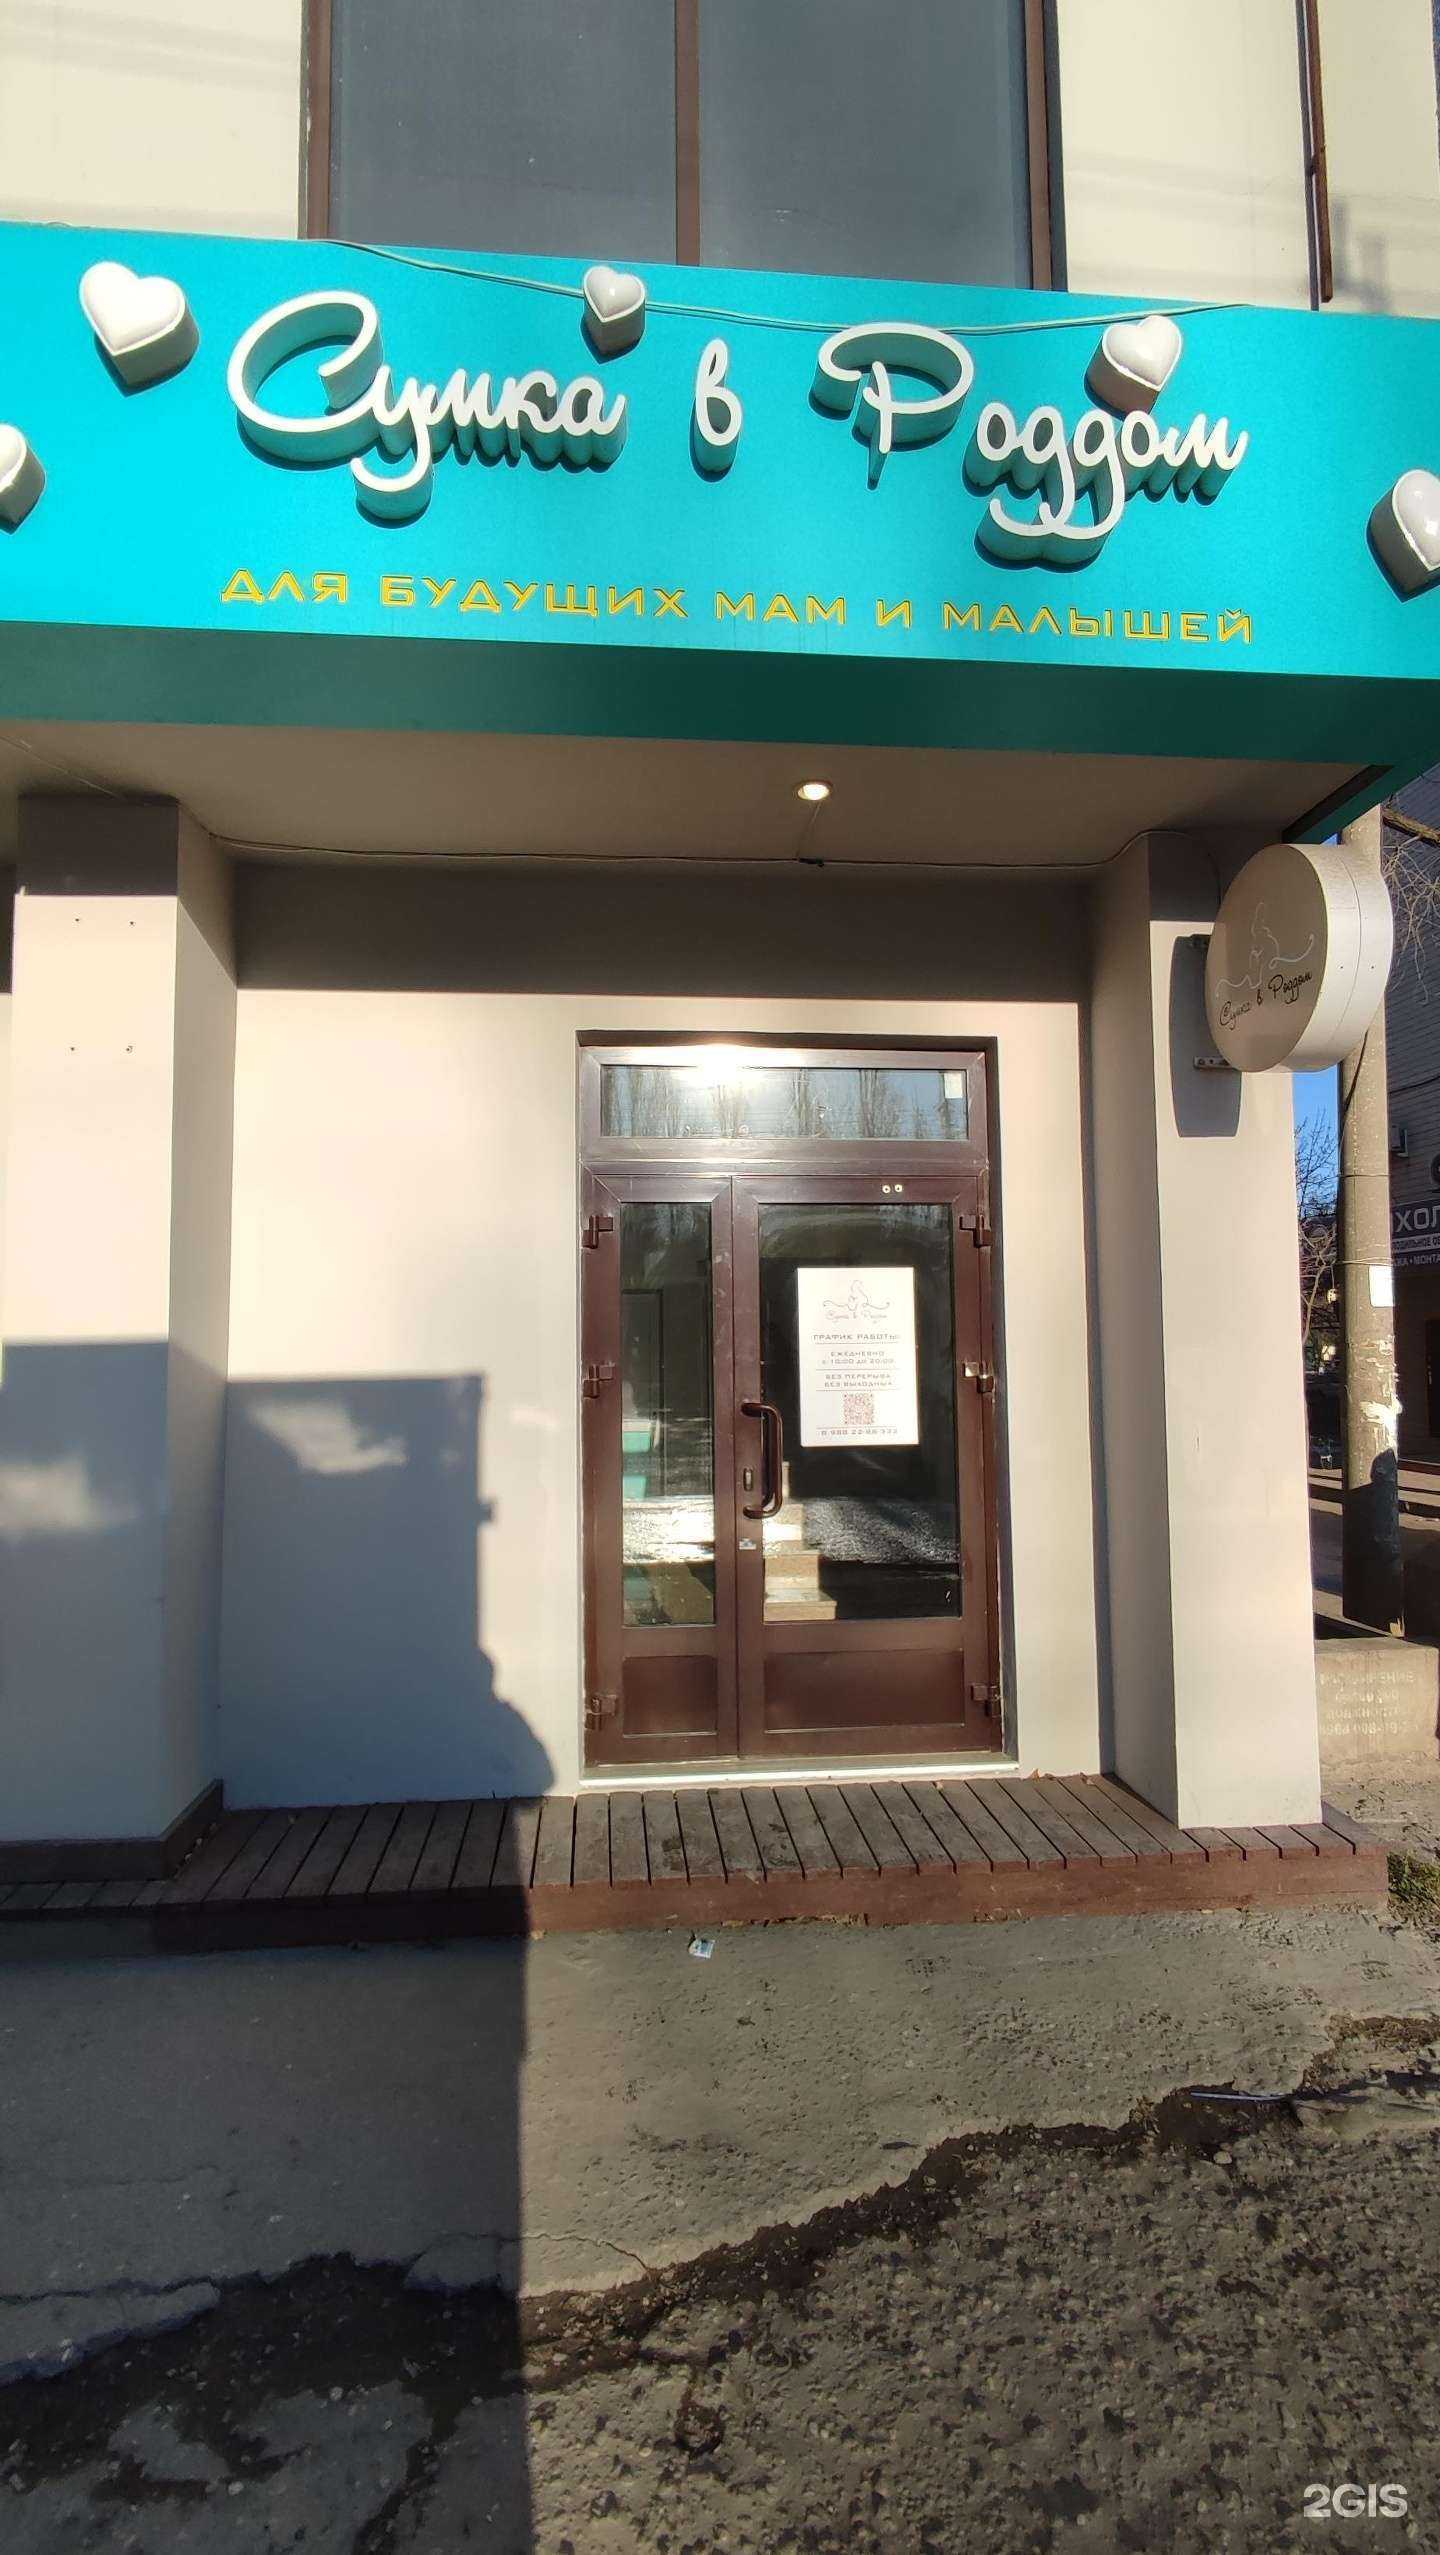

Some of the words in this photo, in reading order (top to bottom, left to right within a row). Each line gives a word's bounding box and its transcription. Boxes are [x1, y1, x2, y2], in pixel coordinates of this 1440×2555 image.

[227, 290, 626, 493] Сумка
[694, 338, 743, 447] в
[817, 321, 1249, 540] Роддом
[220, 567, 348, 603] ДЛЯ
[380, 574, 688, 618] БУДУЩИХ
[714, 592, 847, 626] МАМ
[875, 598, 912, 628] И
[942, 602, 1253, 644] МАЛЫШЕЙ
